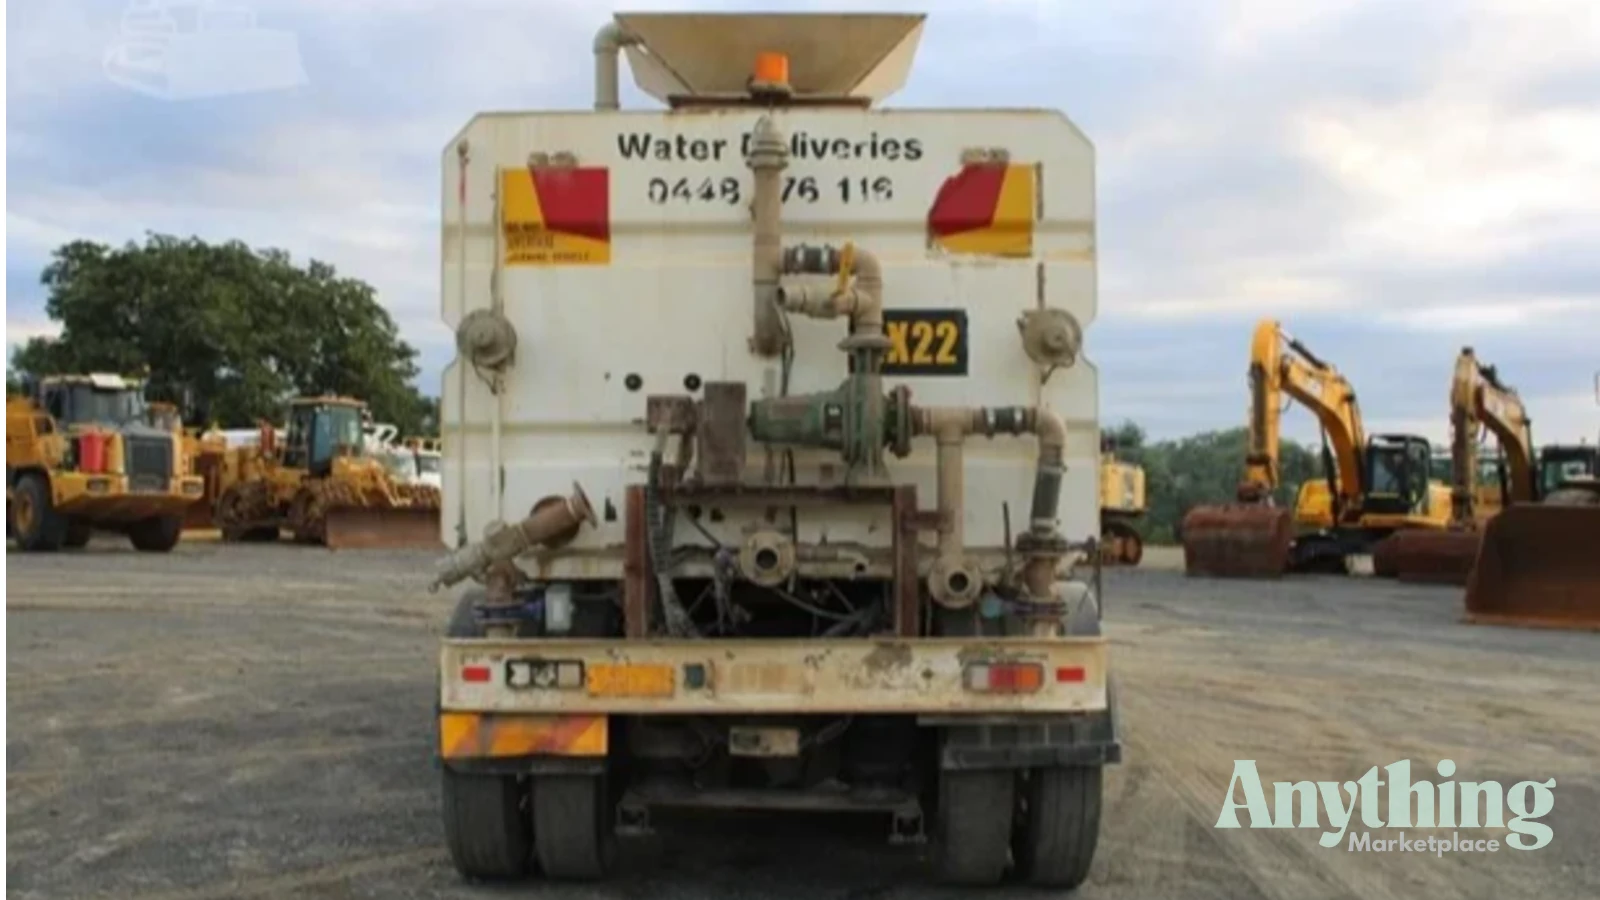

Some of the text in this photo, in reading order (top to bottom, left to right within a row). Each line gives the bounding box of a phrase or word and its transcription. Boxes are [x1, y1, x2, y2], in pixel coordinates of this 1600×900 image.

[617, 131, 924, 161] Water liveries
[885, 319, 958, 365] X22
